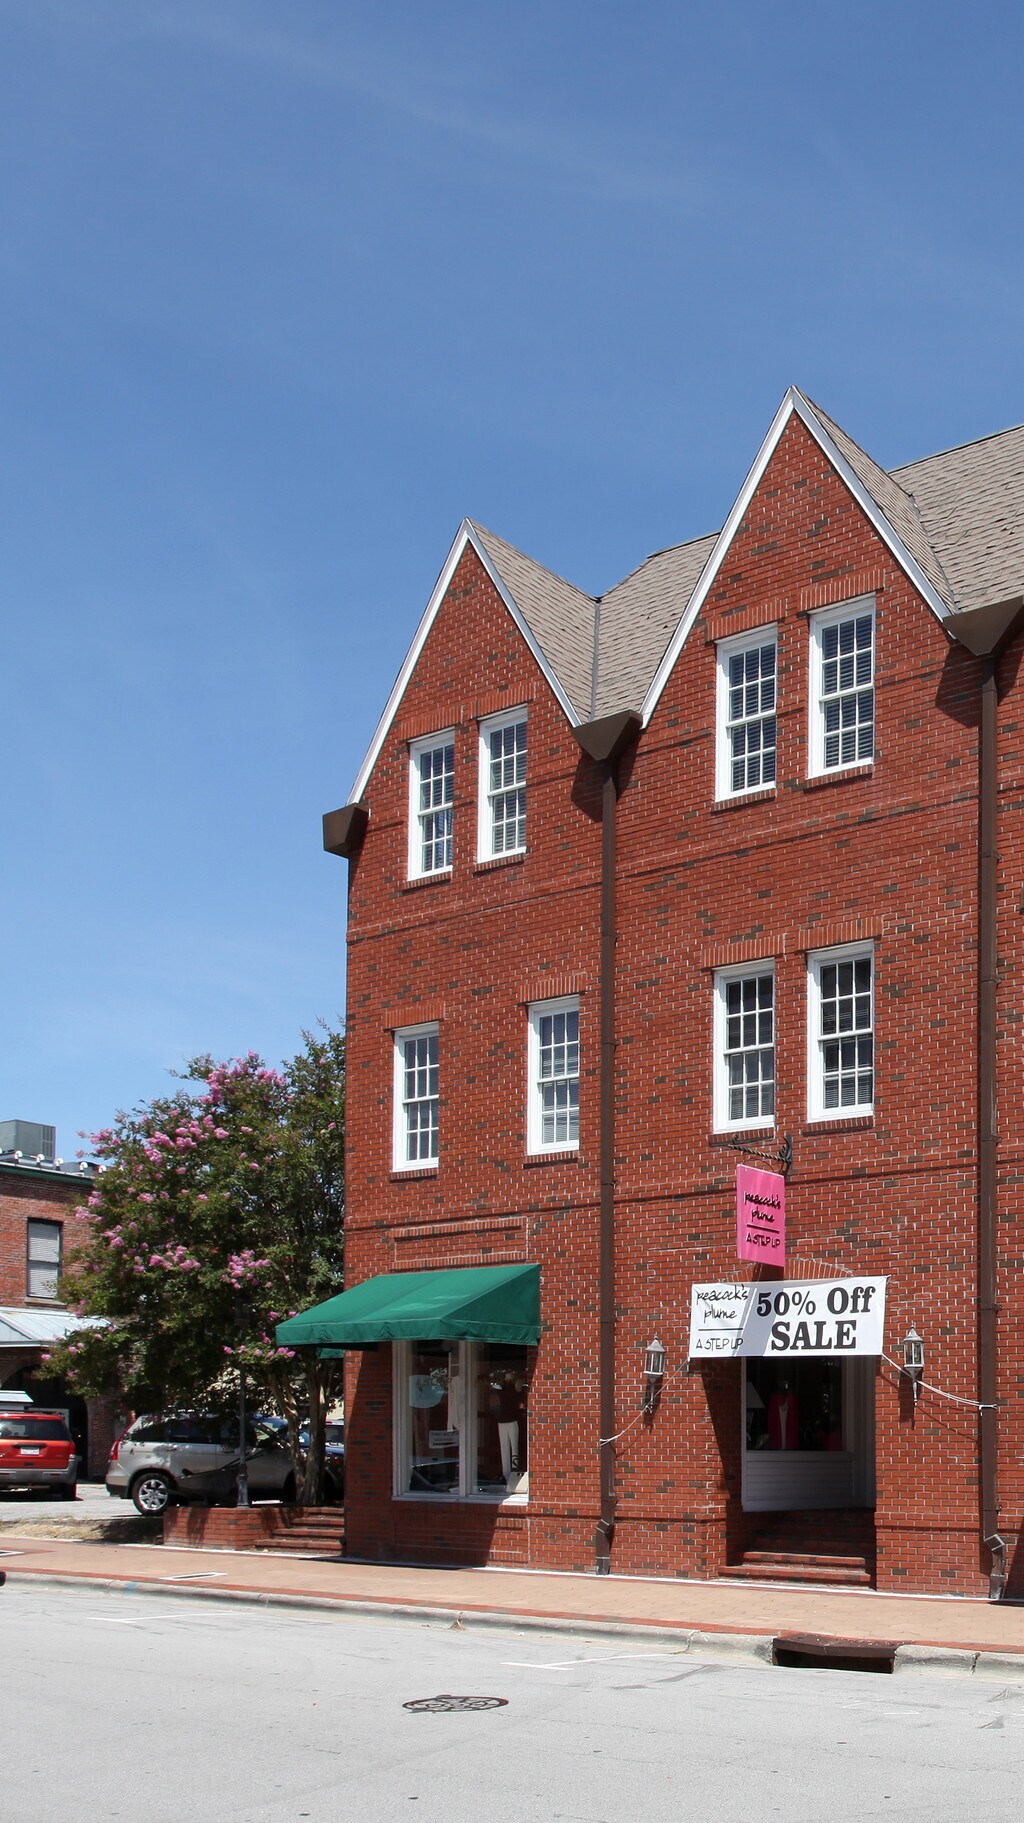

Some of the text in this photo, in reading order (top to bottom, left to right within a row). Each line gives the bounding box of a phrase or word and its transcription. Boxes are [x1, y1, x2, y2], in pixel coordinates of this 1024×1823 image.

[745, 1192, 781, 1210] peacock's
[752, 1206, 775, 1222] plume
[746, 1233, 780, 1248] A STEP UP
[697, 1284, 749, 1306] peacock's
[756, 1286, 876, 1317] 50% Off
[704, 1304, 737, 1324] plume
[696, 1337, 744, 1351] A STEP UP
[771, 1320, 857, 1351] SALE
